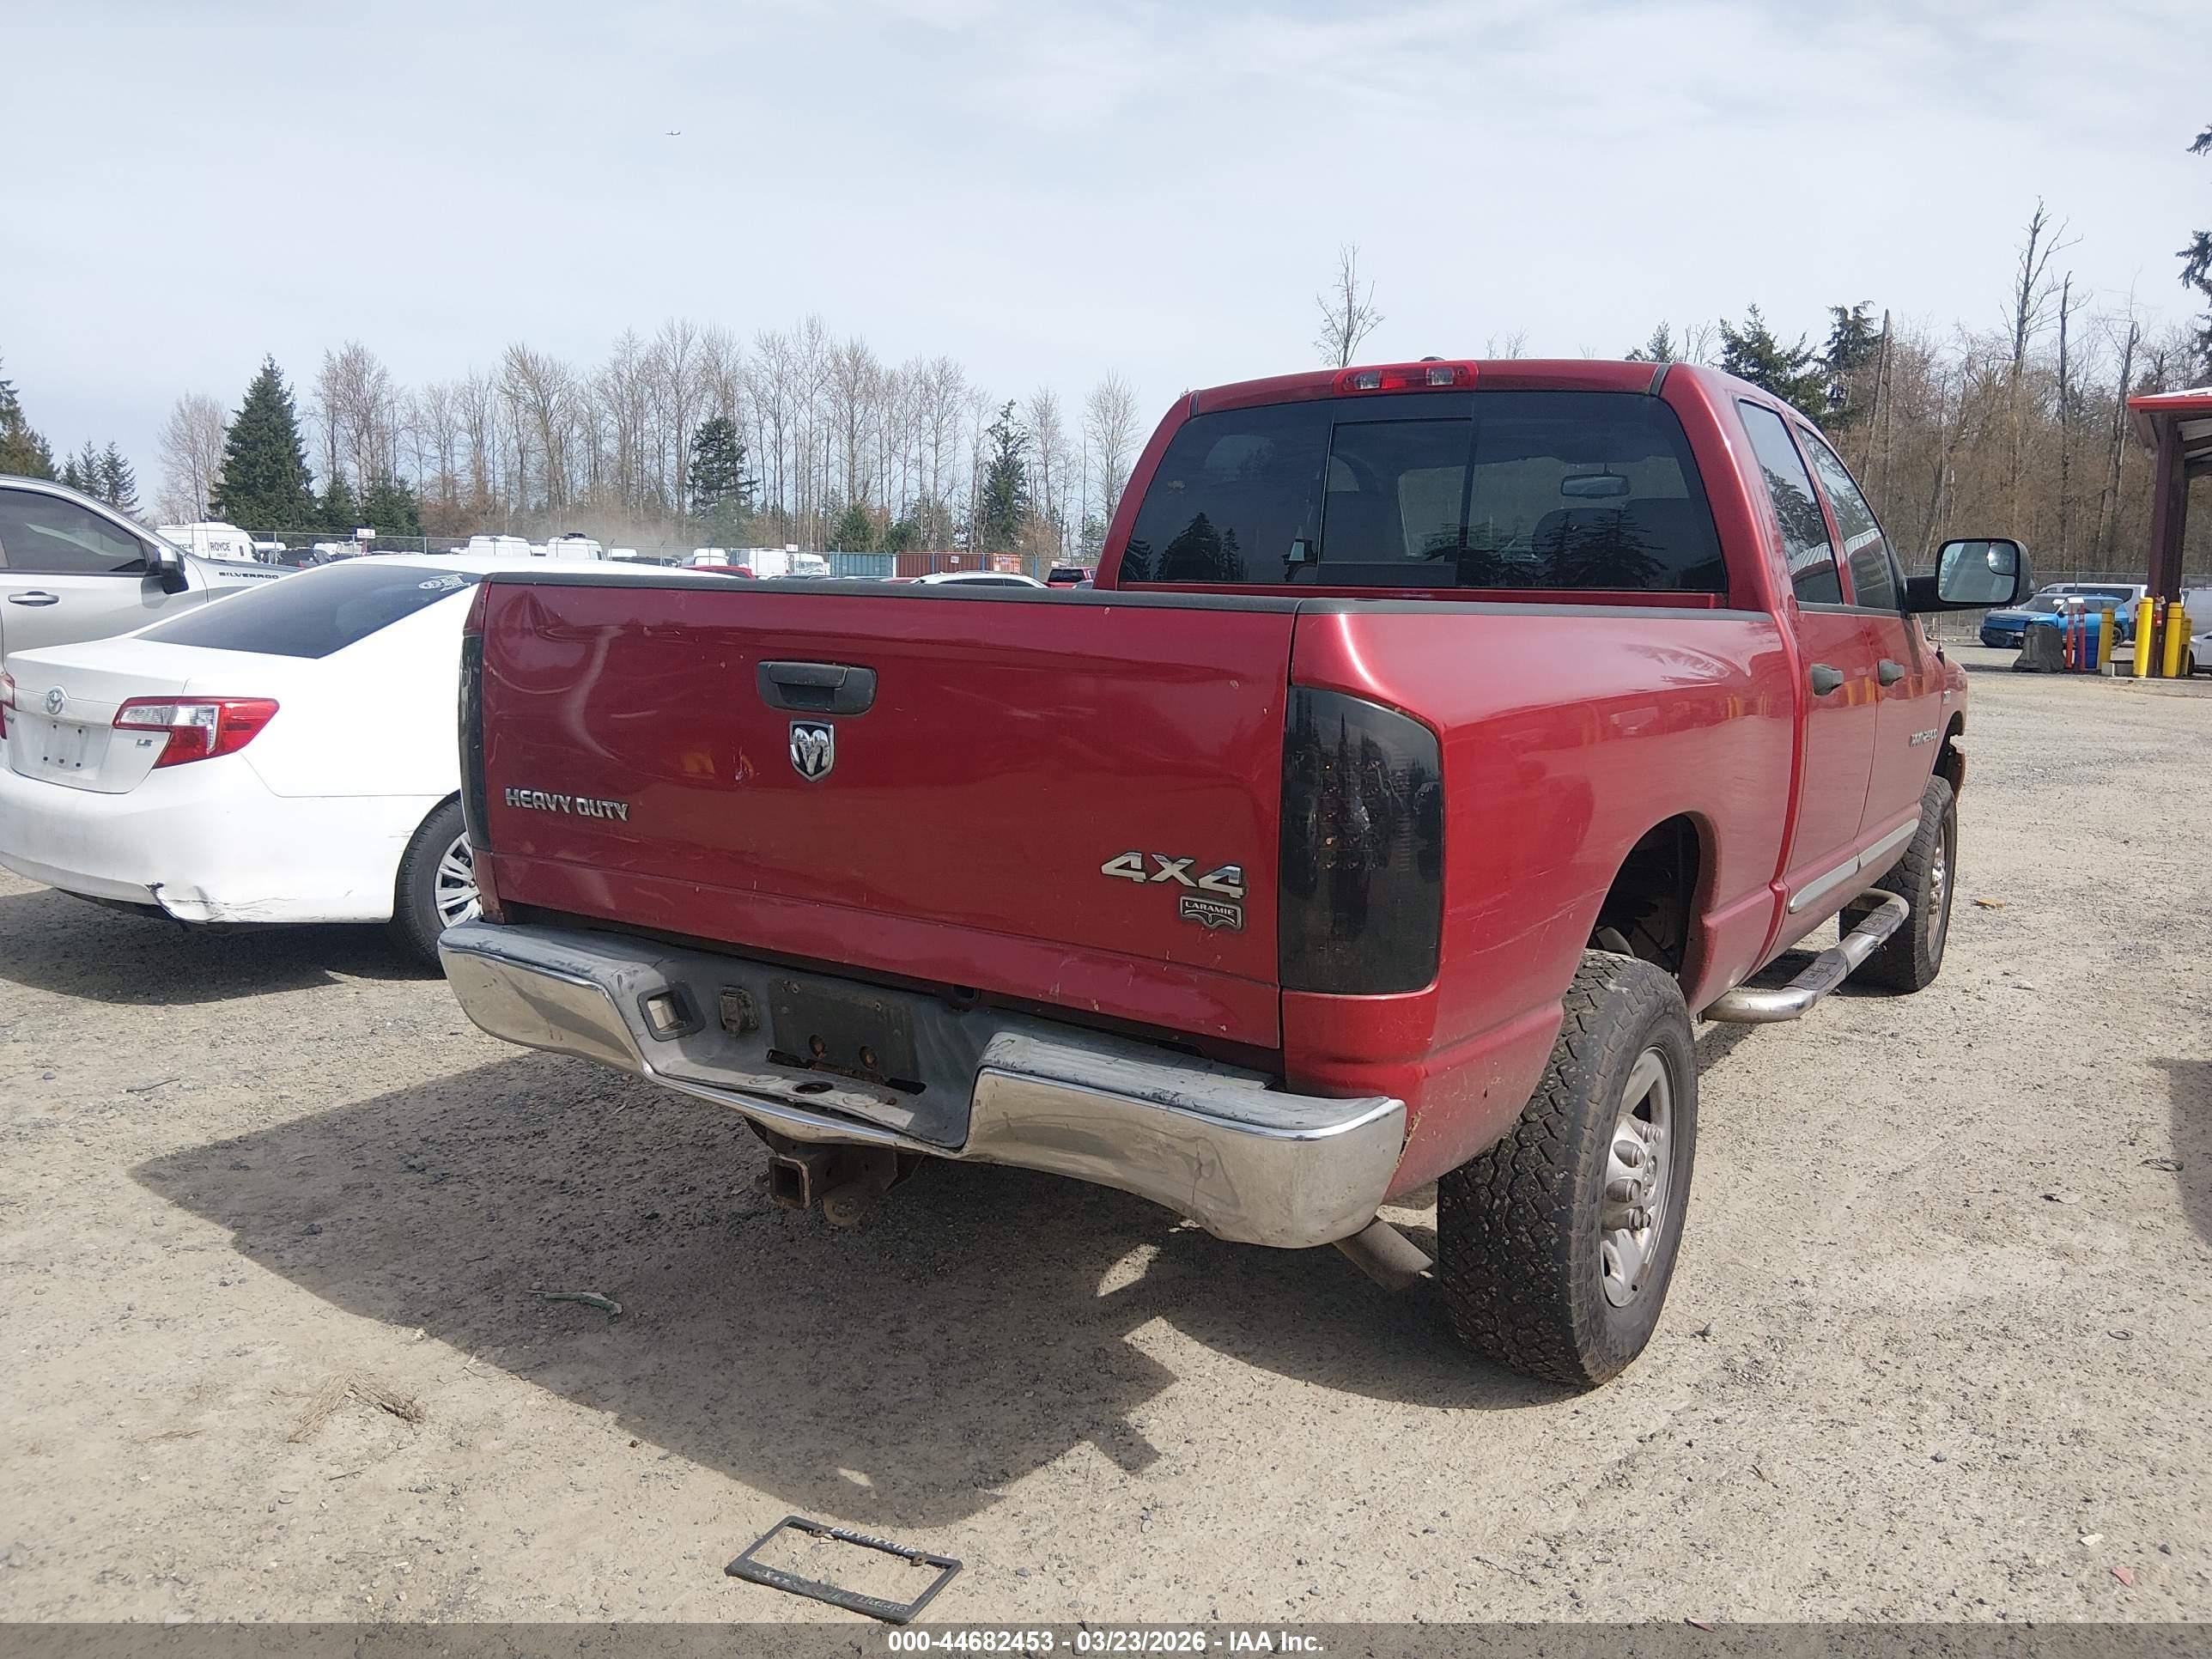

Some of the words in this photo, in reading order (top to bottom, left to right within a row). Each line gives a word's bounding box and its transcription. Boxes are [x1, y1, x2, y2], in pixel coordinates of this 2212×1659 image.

[210, 542, 231, 551] ROYCE
[218, 571, 280, 580] SILVERADO
[505, 787, 571, 814] HEAVY
[575, 797, 629, 822] DUTY
[1184, 901, 1236, 916] LARAMIE
